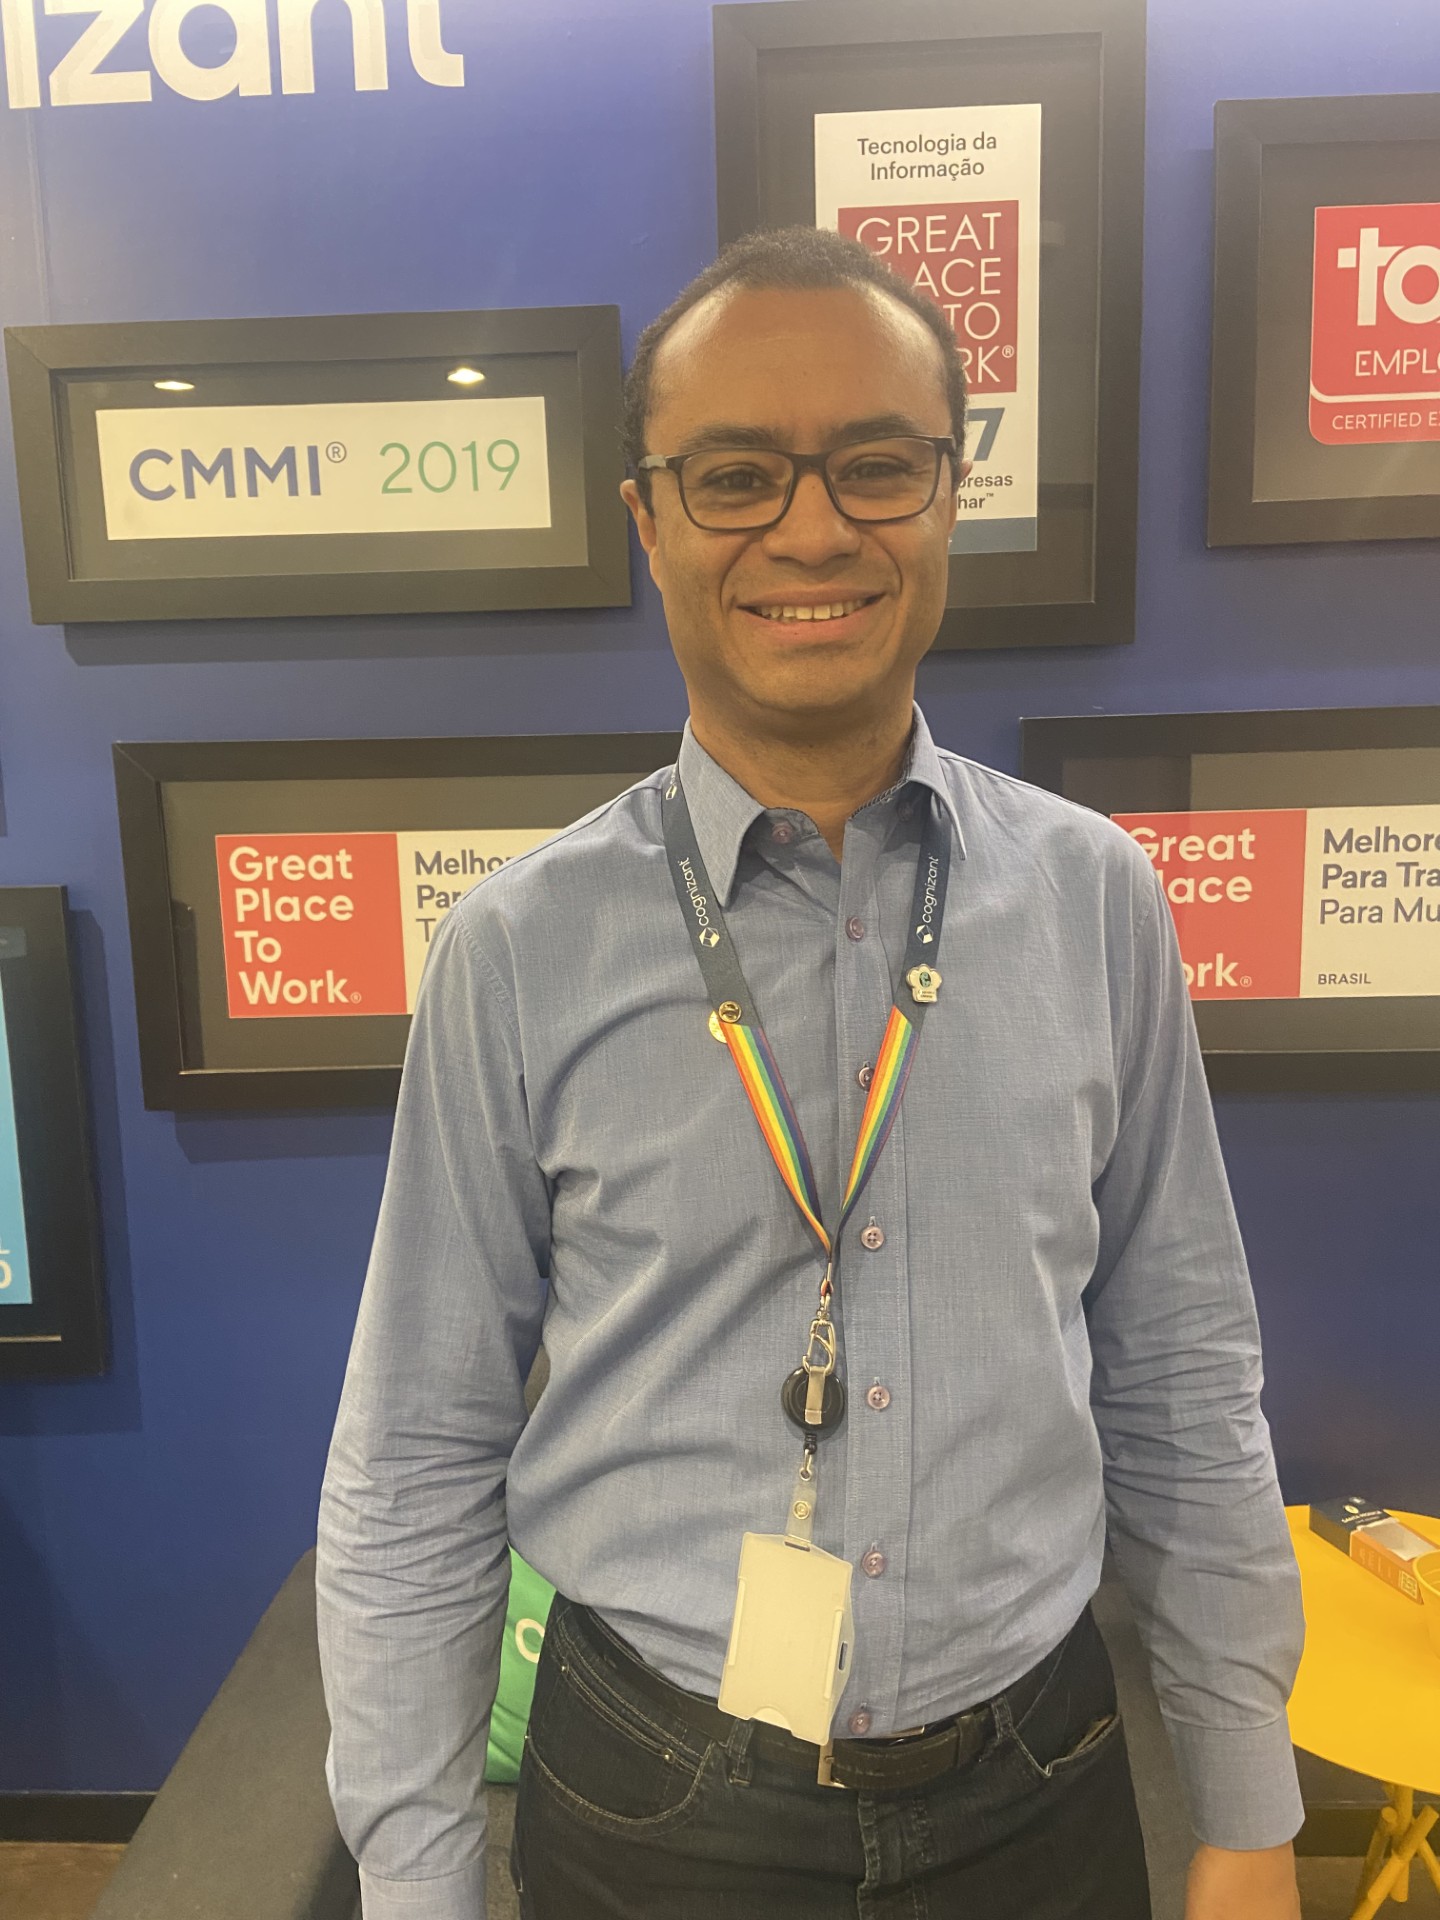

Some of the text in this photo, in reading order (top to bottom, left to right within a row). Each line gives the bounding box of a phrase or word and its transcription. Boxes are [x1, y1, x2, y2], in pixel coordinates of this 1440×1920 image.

[857, 131, 997, 156] Tecnologia da
[870, 158, 985, 182] Informação
[856, 212, 1002, 257] GREAT
[887, 257, 1001, 298] ACE
[942, 301, 1001, 341] TO
[1355, 347, 1440, 377] EMPL
[1332, 411, 1422, 430] CERTIFIED
[379, 438, 520, 495] 2019
[229, 846, 353, 882] Great
[1322, 861, 1440, 889] Para Tra
[235, 887, 354, 922] Place
[677, 857, 710, 926] cognizant
[922, 856, 939, 924] cognizant
[1319, 898, 1383, 925] Para
[234, 930, 282, 963] To
[1317, 972, 1372, 985] BRASIL
